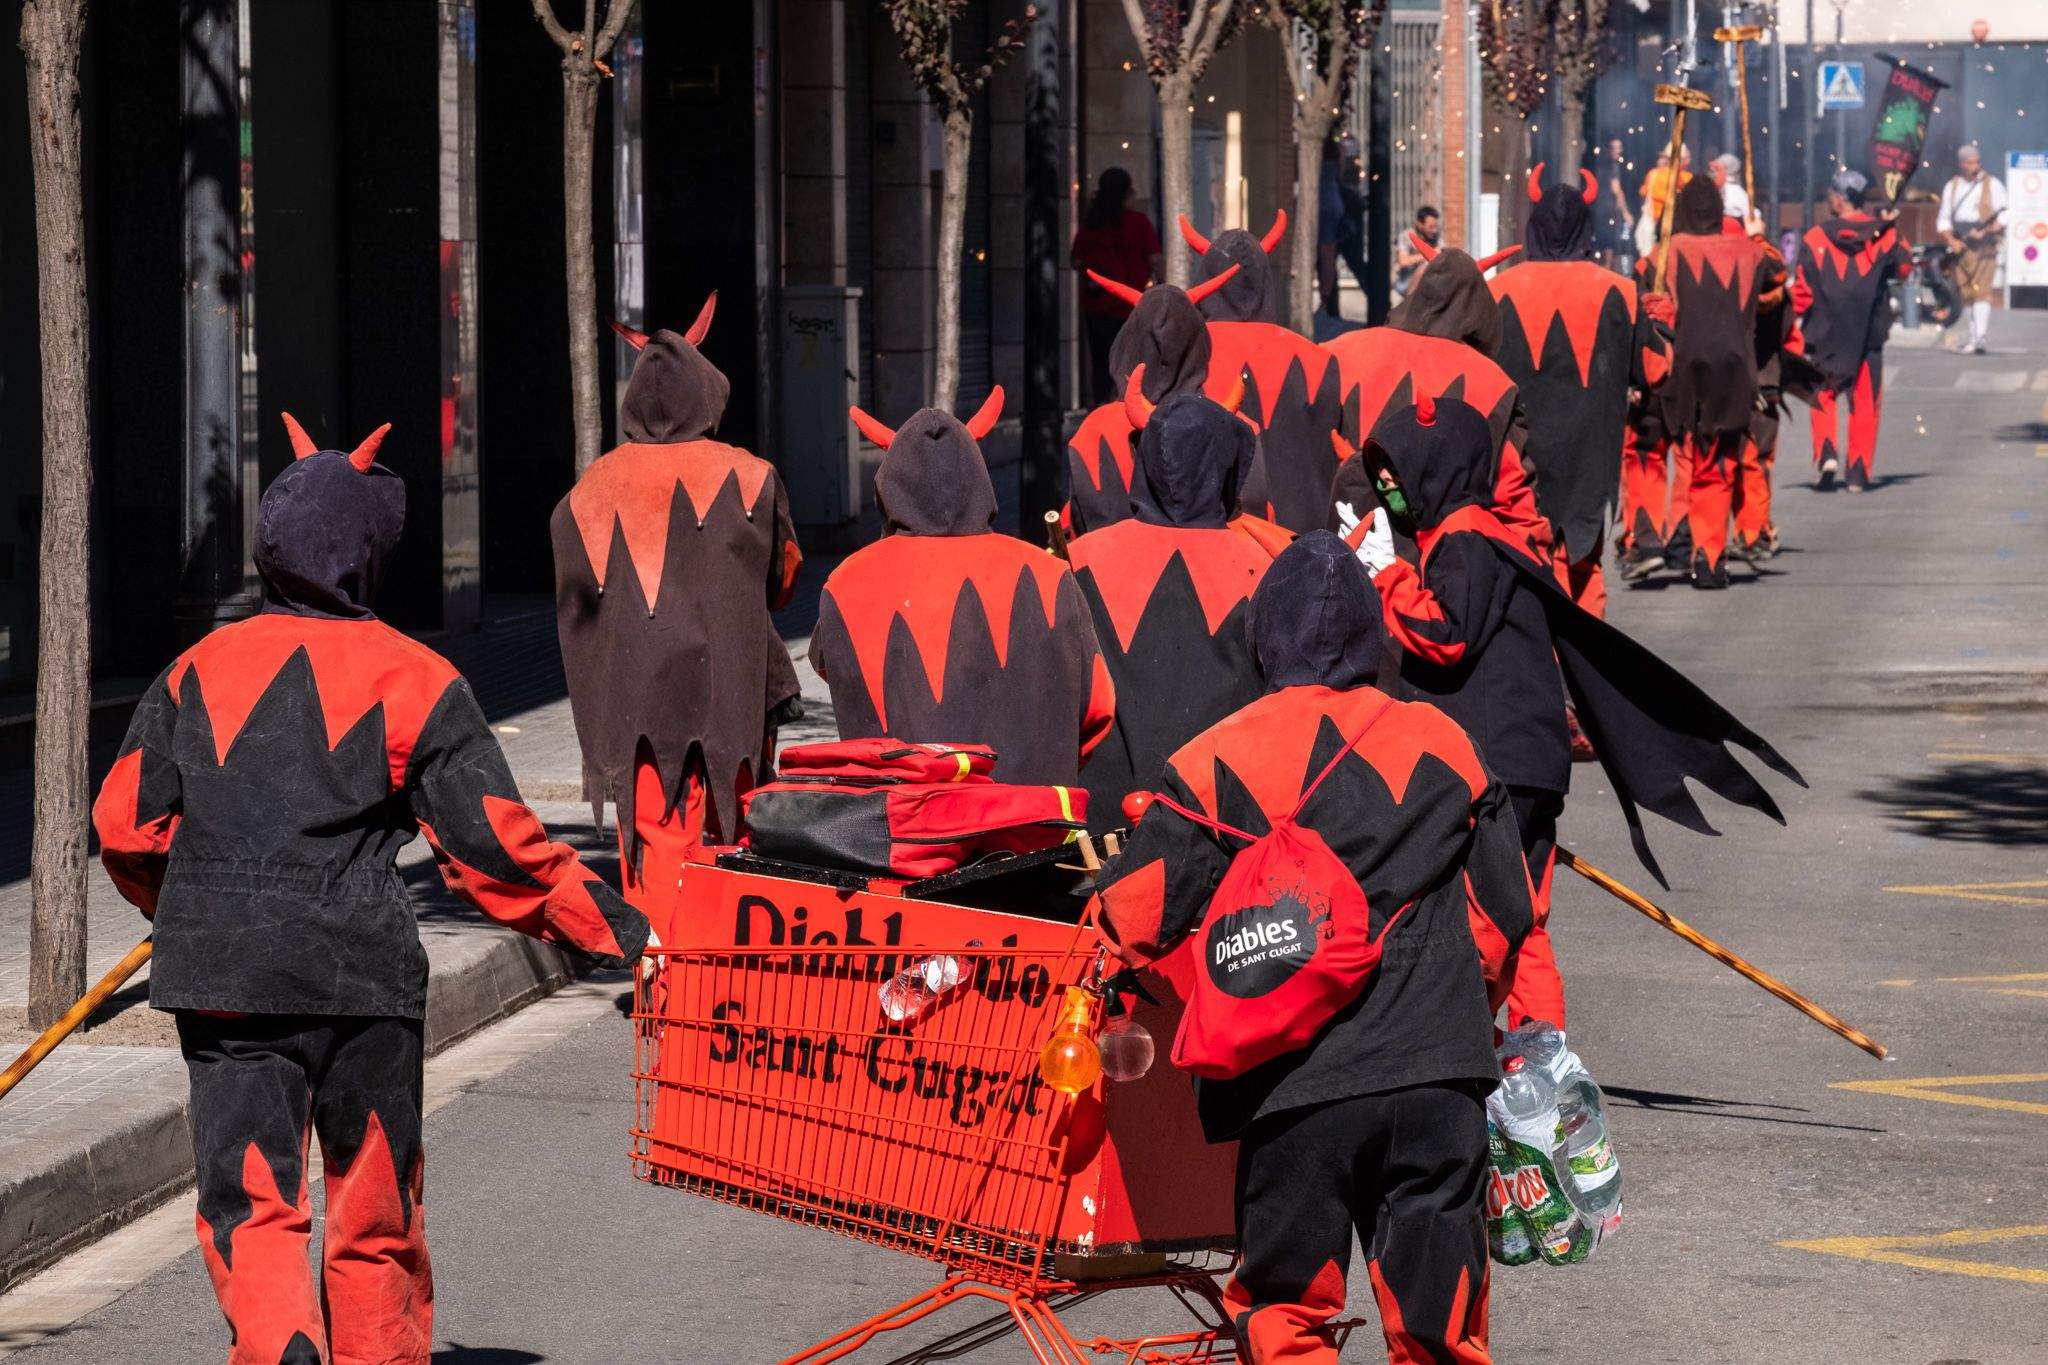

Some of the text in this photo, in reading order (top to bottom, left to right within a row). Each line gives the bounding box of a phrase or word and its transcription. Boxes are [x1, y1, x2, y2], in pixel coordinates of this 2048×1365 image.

[1216, 919, 1298, 965] Diables
[1227, 942, 1303, 973] DE SANT CUGAT
[709, 1001, 841, 1083] Sant
